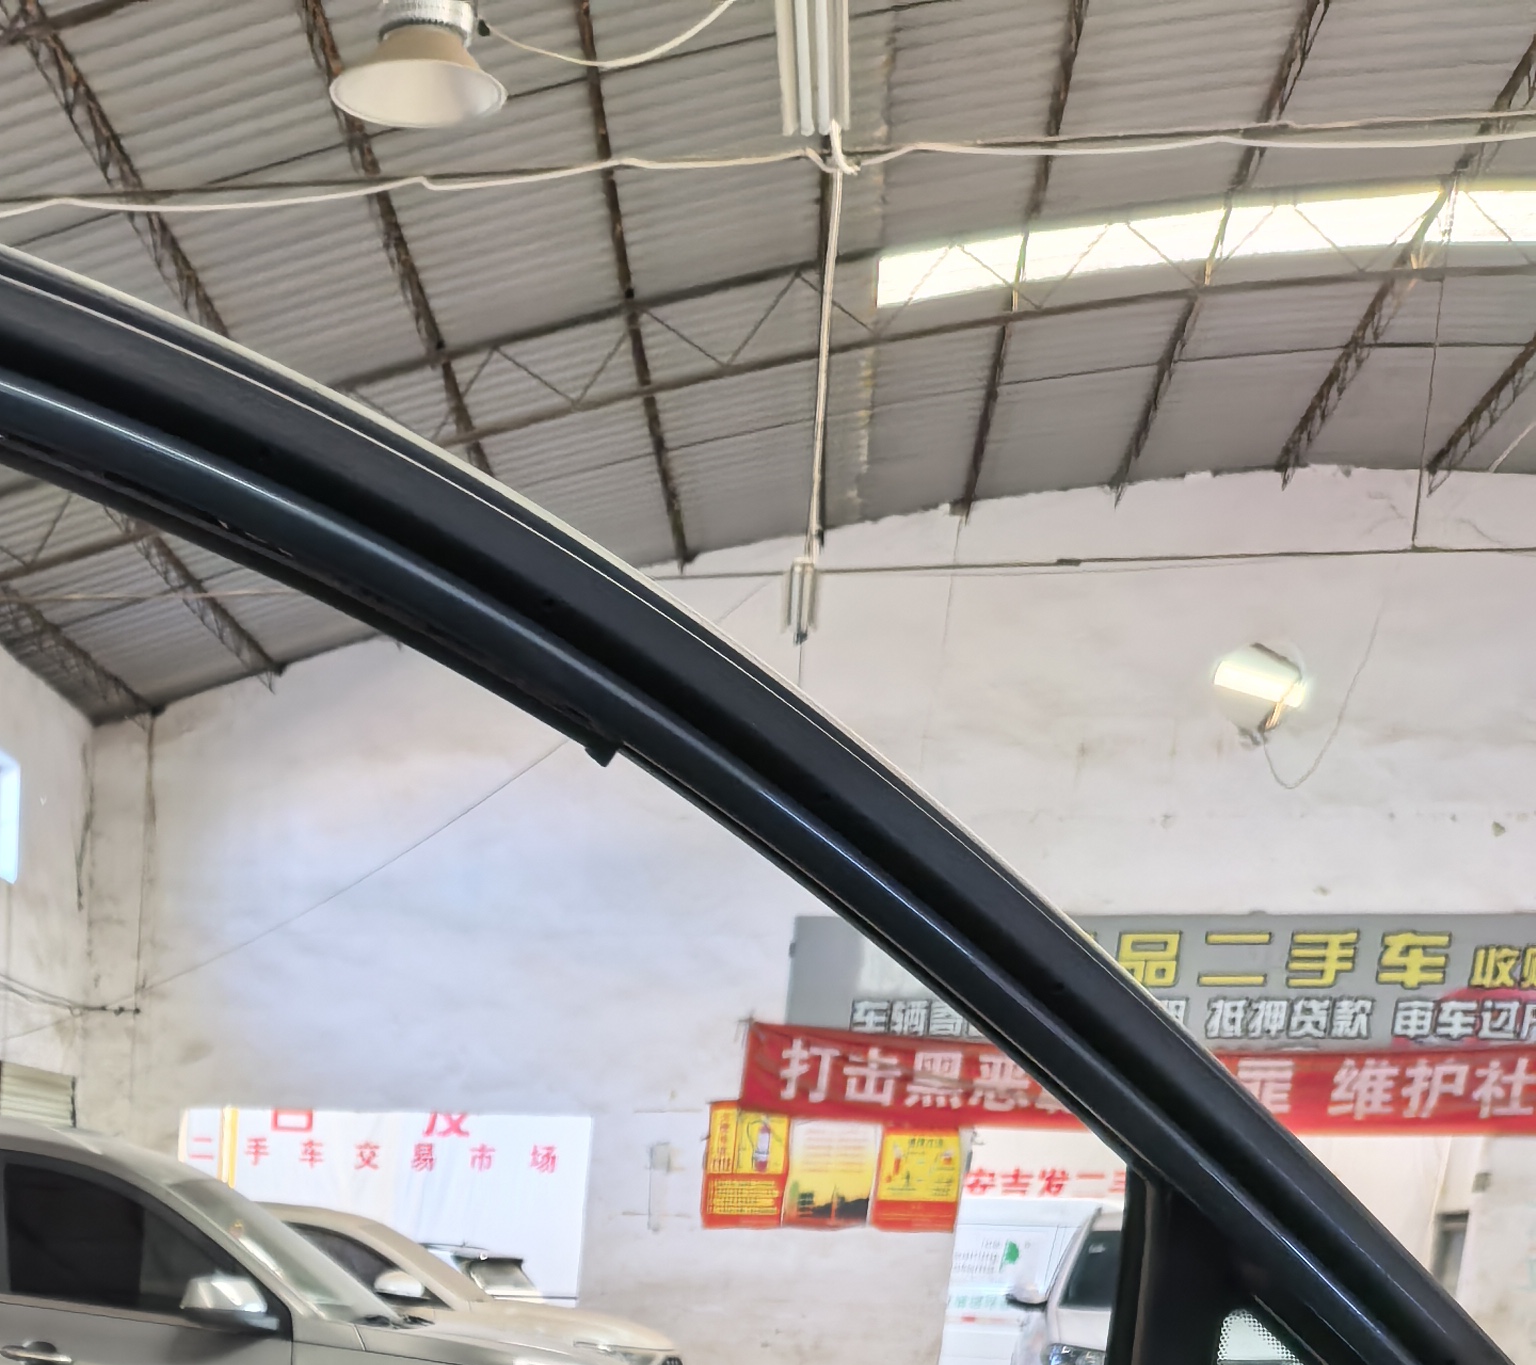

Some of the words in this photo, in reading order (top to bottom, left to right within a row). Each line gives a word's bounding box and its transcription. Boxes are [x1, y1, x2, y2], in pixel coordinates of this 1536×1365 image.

[1086, 930, 1452, 989] 品二手车
[850, 1000, 986, 1038] 车辆寄
[1205, 998, 1372, 1039] 抵押贷款
[780, 1038, 1075, 1114] 打击黑恶
[1327, 1056, 1536, 1120] 维护社
[188, 1136, 559, 1175] 二手车交易市场
